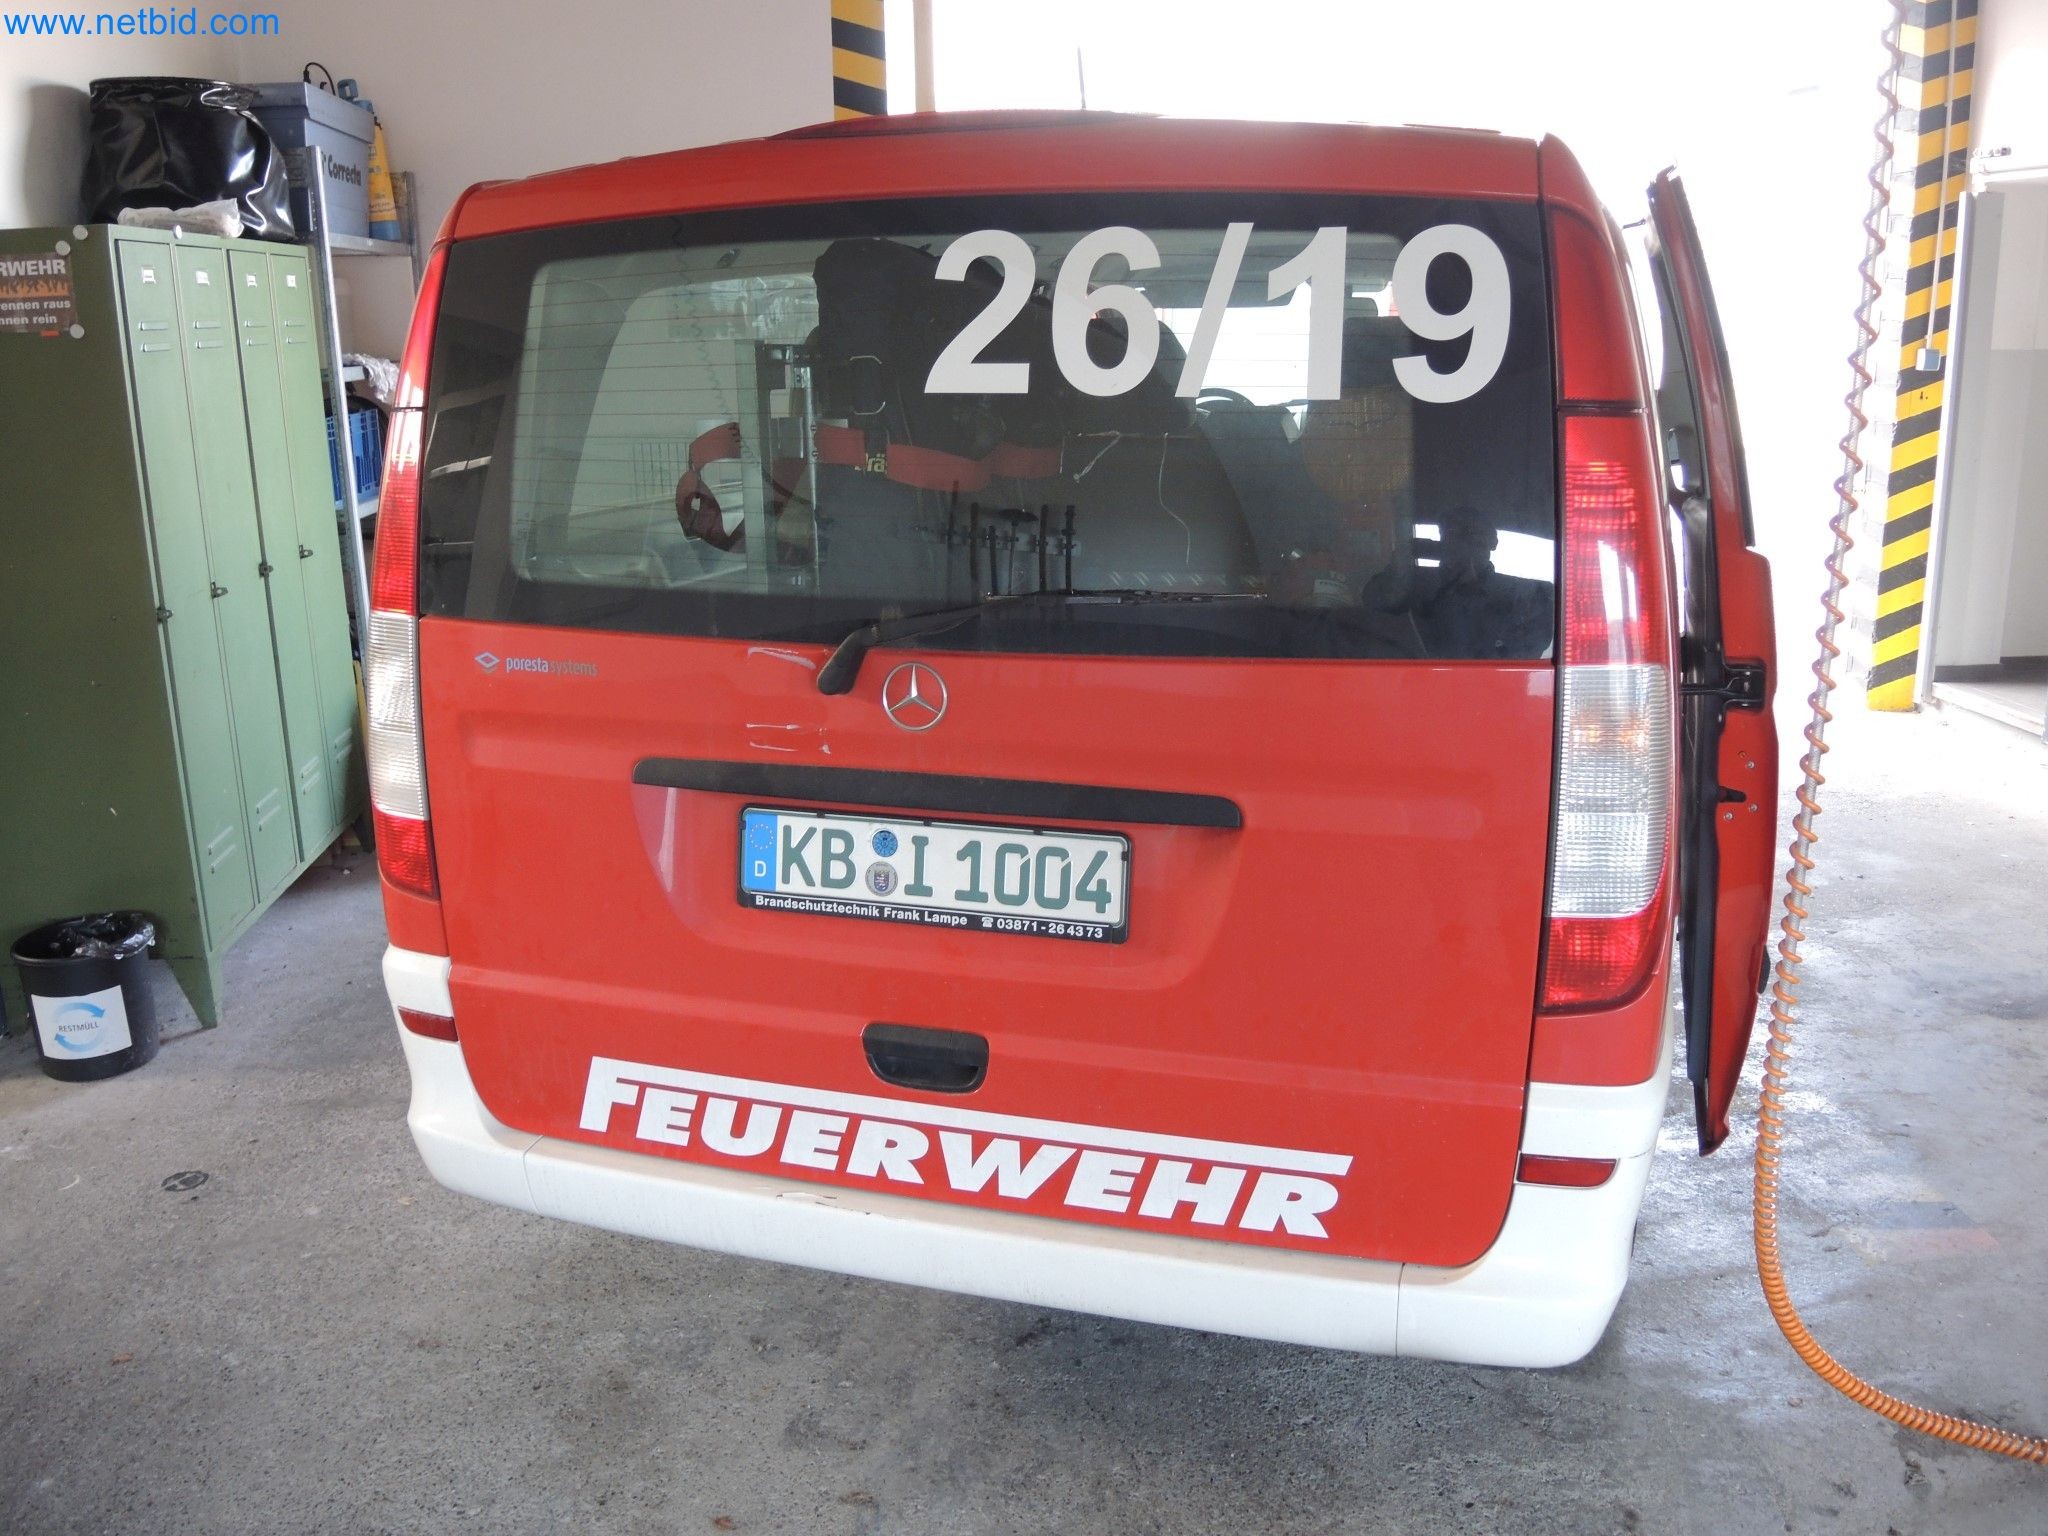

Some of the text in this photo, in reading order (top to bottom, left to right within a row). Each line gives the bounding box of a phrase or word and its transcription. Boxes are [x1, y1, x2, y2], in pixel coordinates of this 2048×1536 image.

[0, 300, 71, 311] ennen raus
[924, 221, 1512, 404] 26/19
[32, 313, 57, 324] rein
[754, 860, 767, 877] D
[781, 824, 857, 889] KB
[954, 840, 1112, 914] 1004
[755, 895, 880, 917] Brandschutztechnik
[883, 907, 920, 922] Frank
[924, 910, 968, 926] Lampe
[58, 1022, 100, 1032] RESTMÜLL
[579, 1056, 1354, 1239] FEUERWEHR
